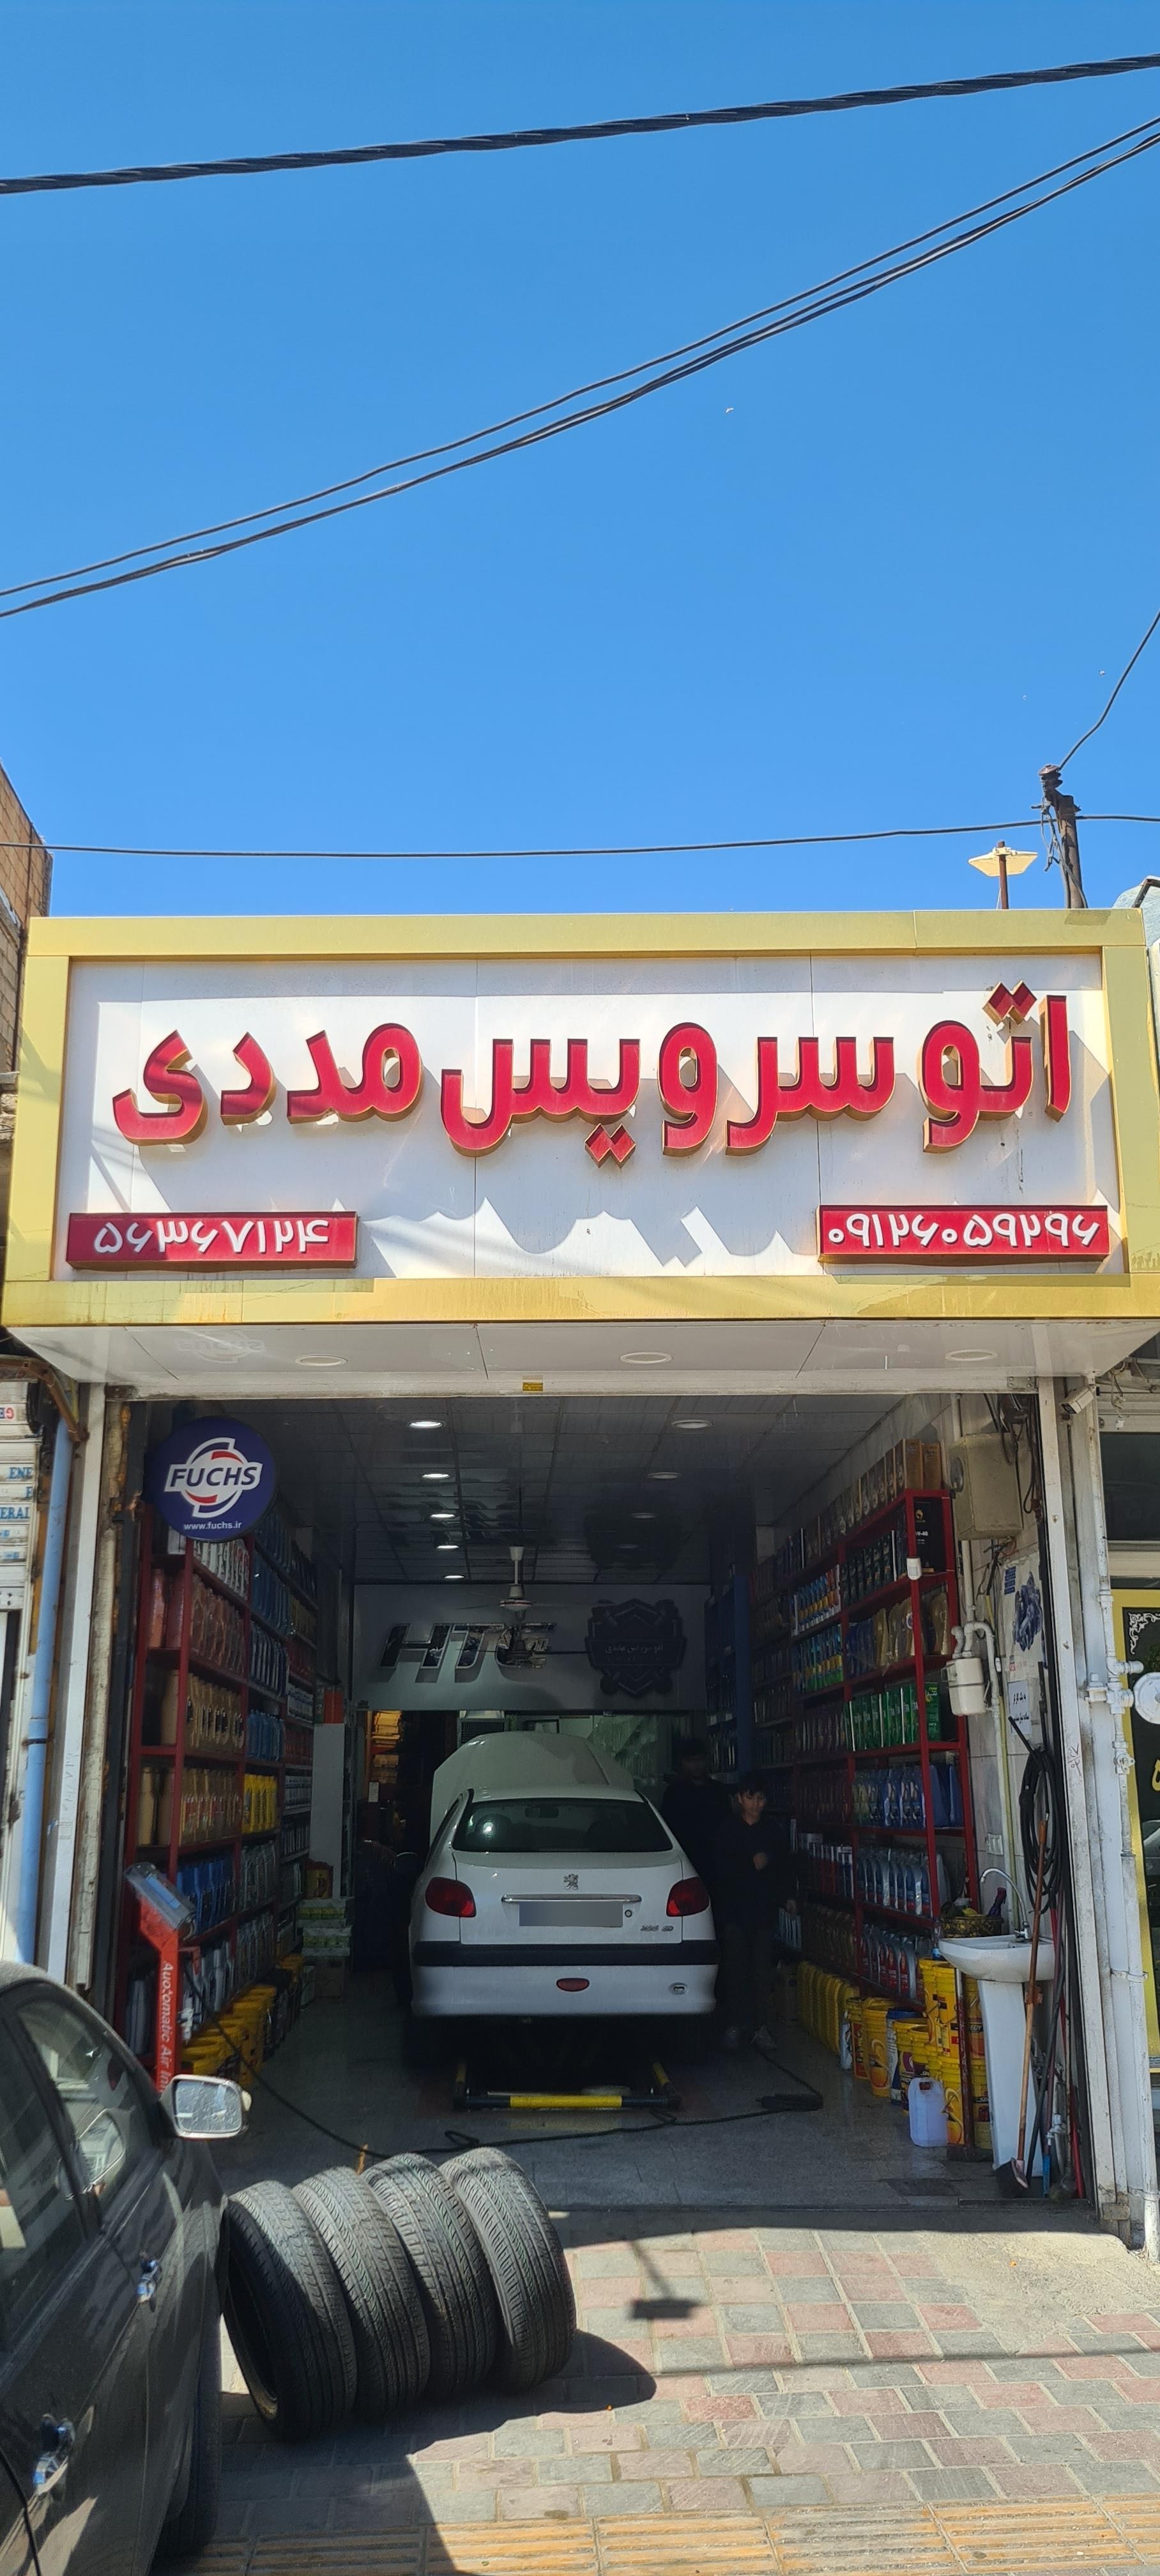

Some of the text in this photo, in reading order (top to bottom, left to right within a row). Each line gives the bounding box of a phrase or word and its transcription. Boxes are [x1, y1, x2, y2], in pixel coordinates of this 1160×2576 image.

[112, 980, 1072, 1169] اتو سرویس مددی
[94, 1219, 329, 1254] ۵۶۳۶۷۱۲۴
[828, 1213, 1101, 1247] ۰۹۱۲۶۰۵۹۲۹۶
[170, 1466, 258, 1487] FUCHS
[183, 1521, 243, 1531] www.fuchs.ir
